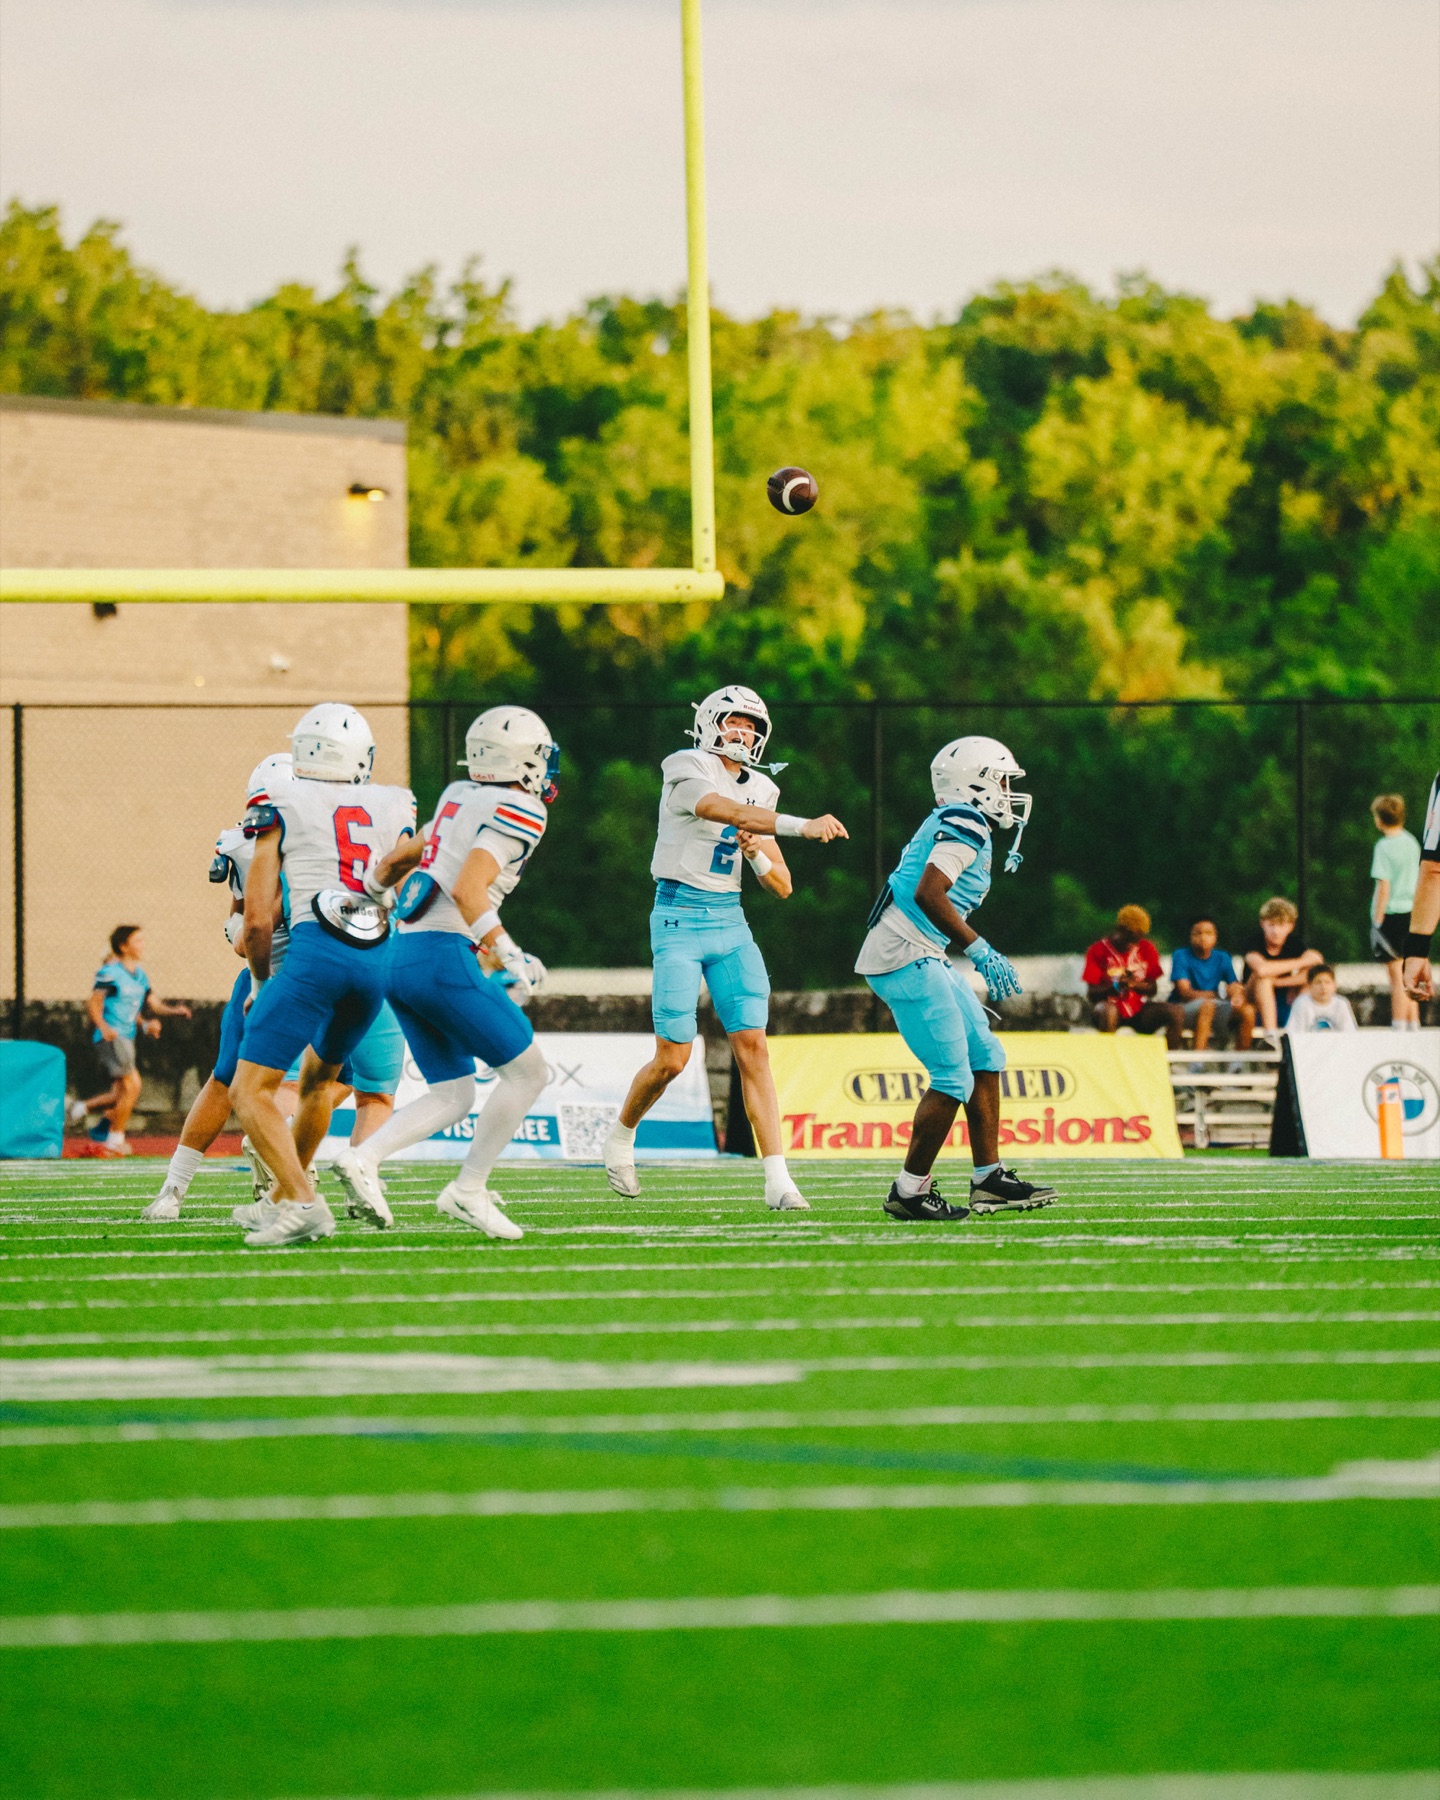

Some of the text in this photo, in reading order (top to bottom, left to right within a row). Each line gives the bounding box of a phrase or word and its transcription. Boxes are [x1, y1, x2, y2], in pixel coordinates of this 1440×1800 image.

[332, 805, 373, 894] 6
[418, 800, 462, 870] 5
[709, 825, 740, 876] 2
[852, 1070, 1065, 1101] CERIED
[783, 1107, 1152, 1150] Transssions
